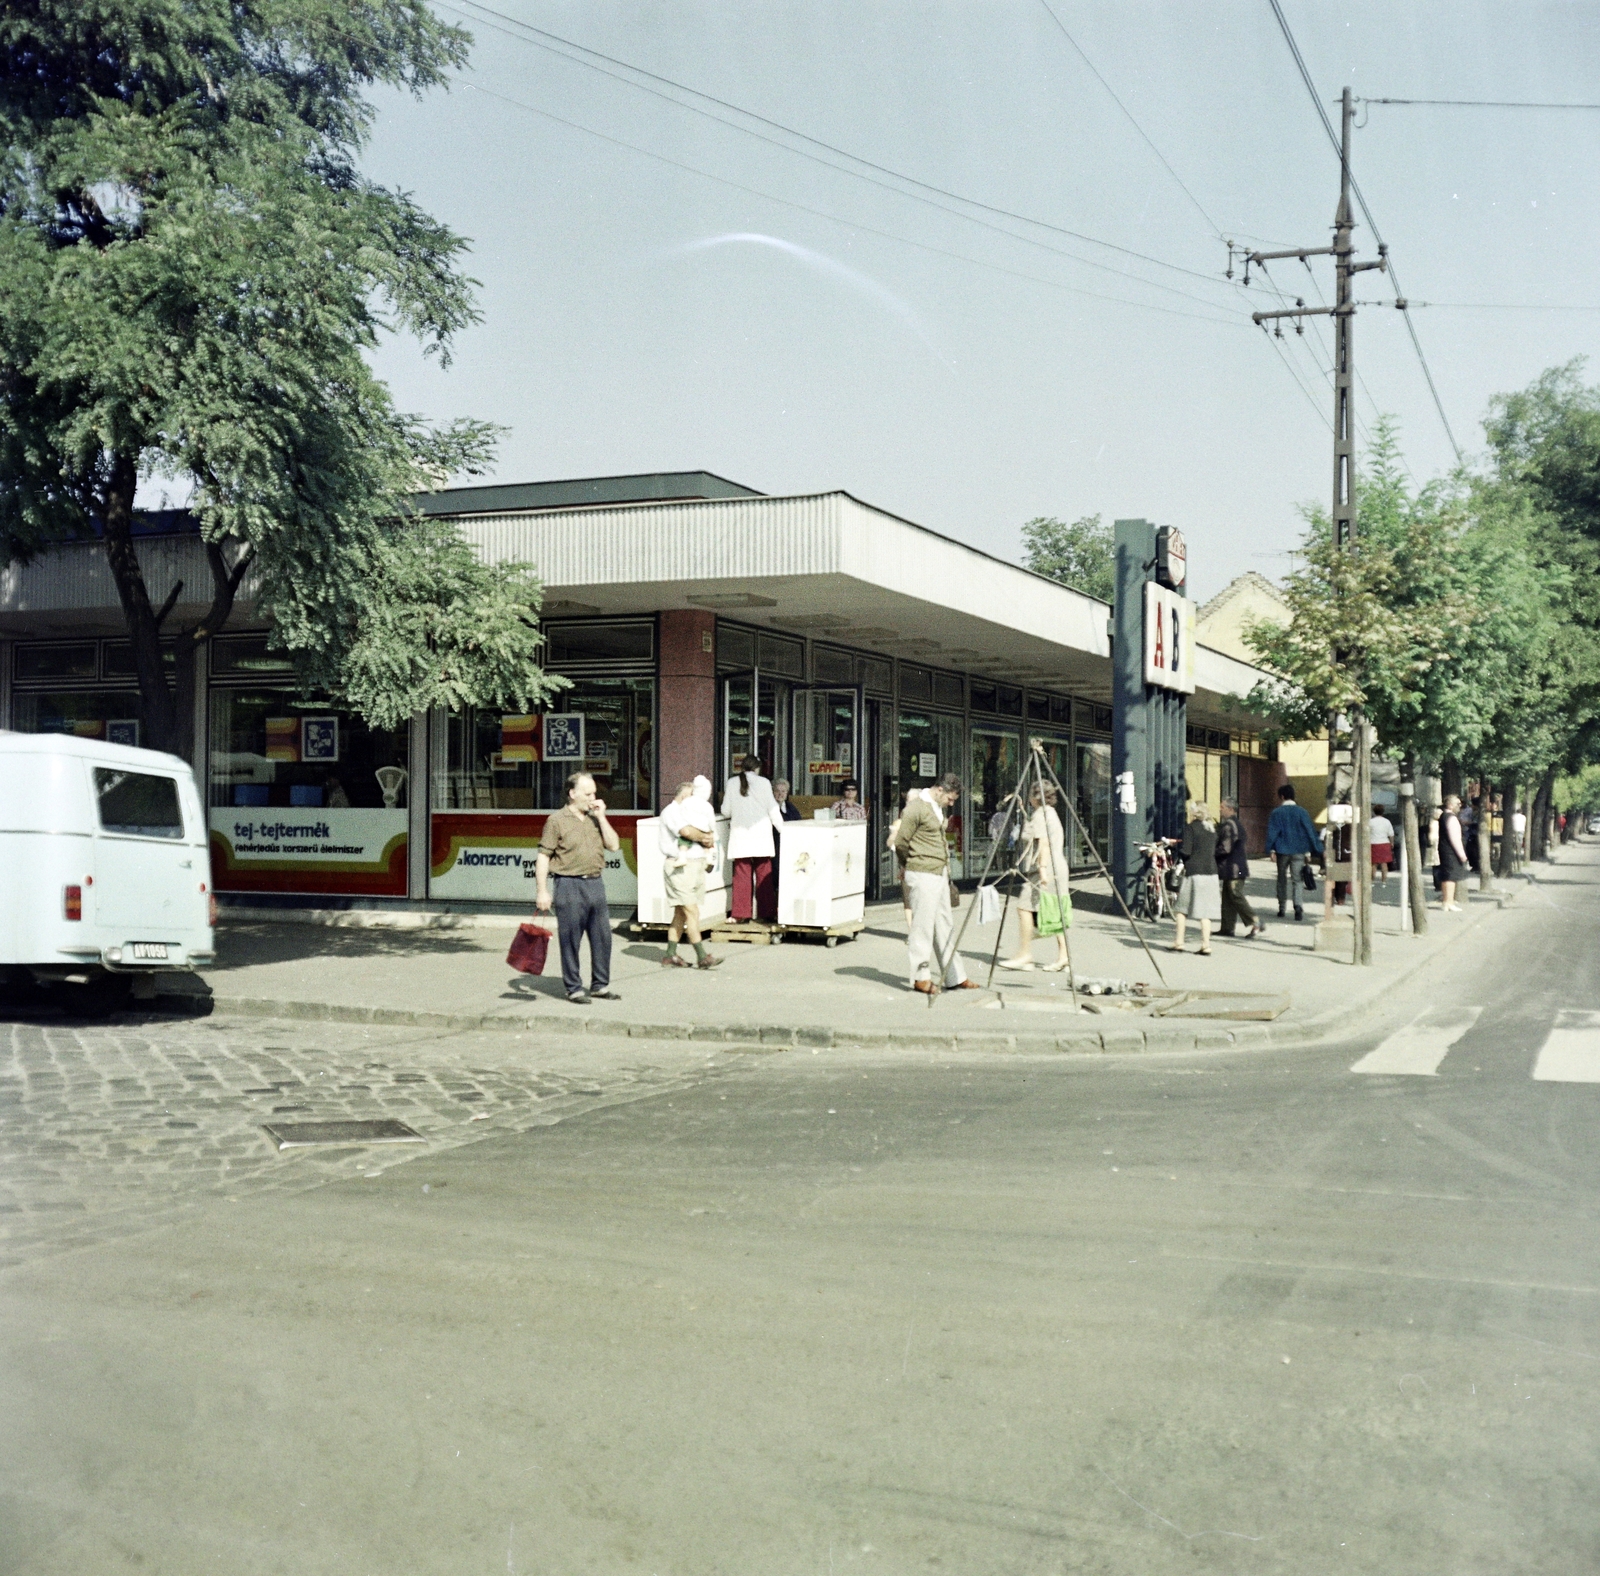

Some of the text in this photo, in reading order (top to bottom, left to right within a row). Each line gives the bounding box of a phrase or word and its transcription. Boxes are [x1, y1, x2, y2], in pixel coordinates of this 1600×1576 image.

[234, 822, 330, 841] tej-tejtermék
[457, 859, 464, 867] a
[463, 850, 522, 867] konzerv
